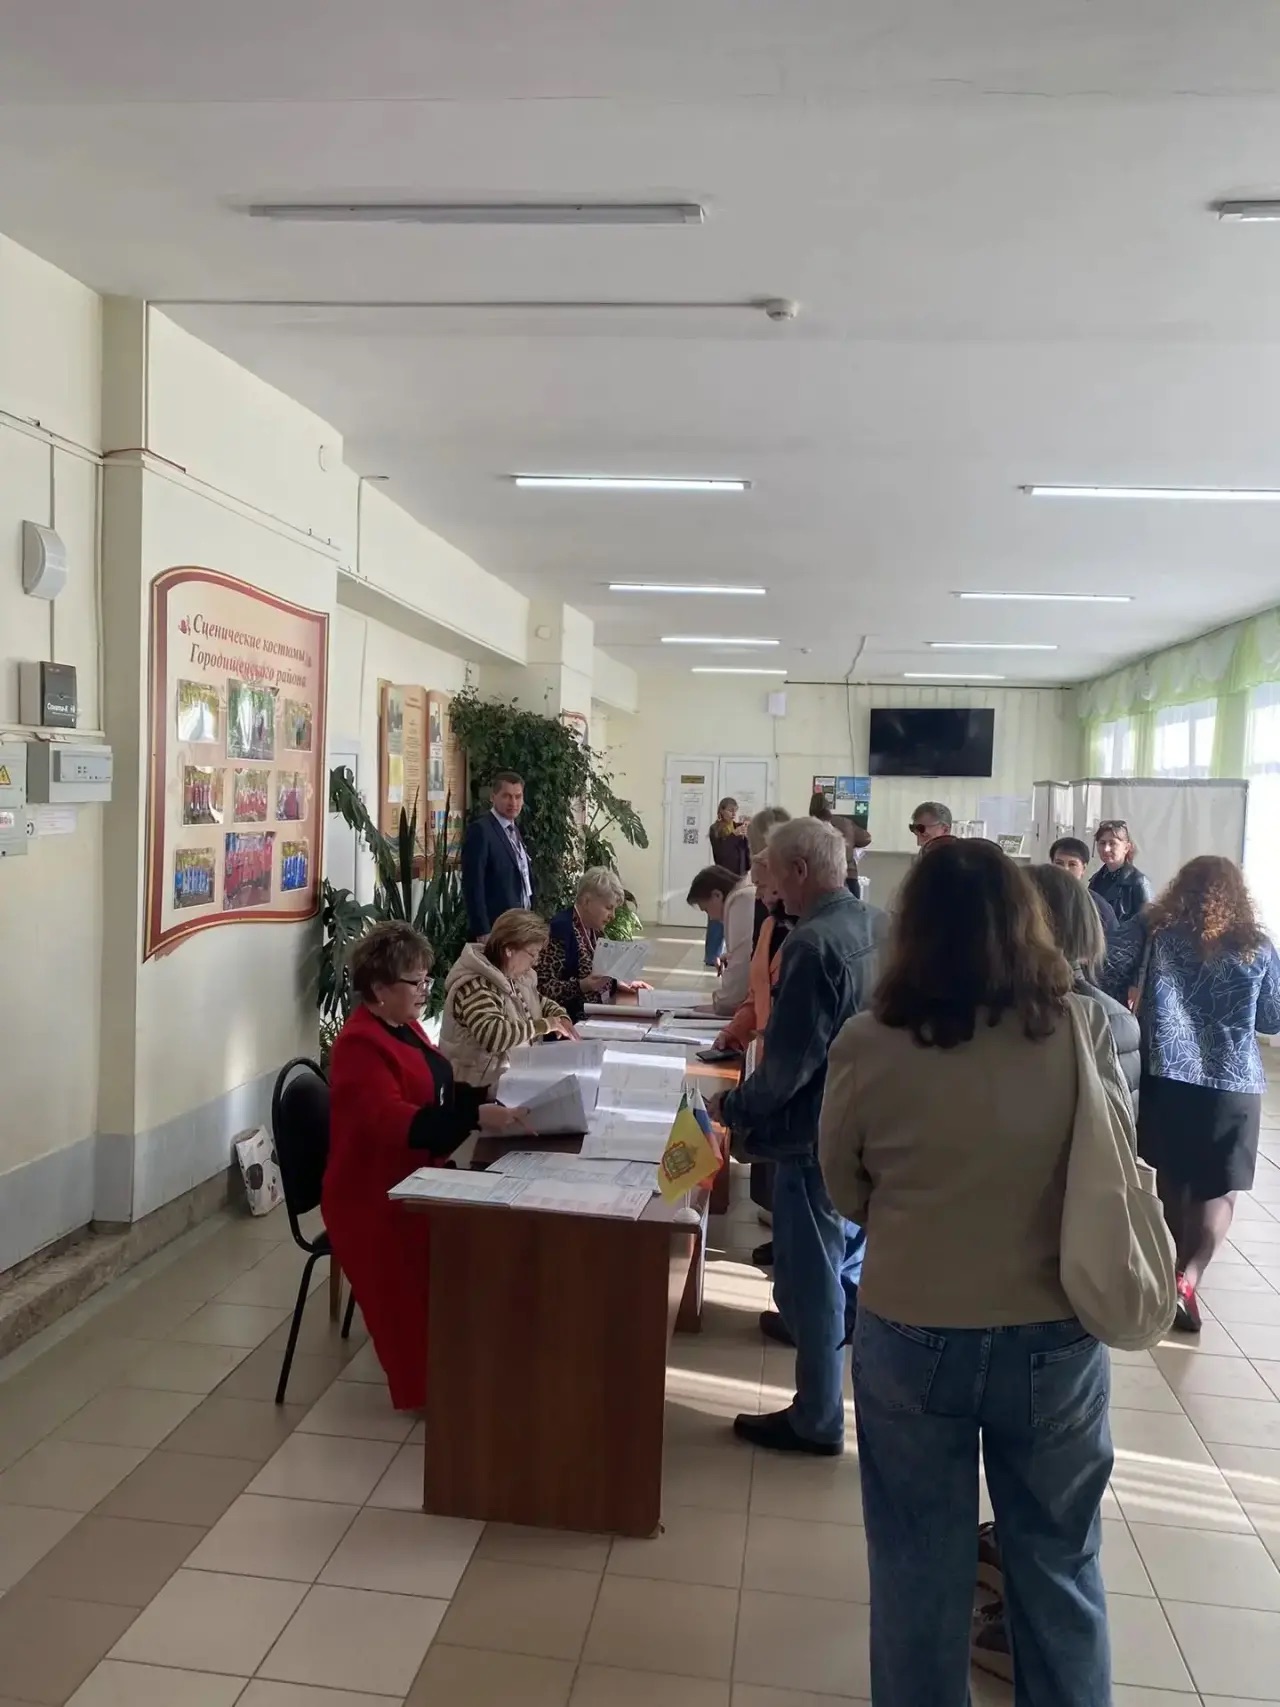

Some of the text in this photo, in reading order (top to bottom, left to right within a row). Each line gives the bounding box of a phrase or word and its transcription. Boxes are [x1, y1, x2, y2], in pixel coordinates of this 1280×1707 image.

[193, 613, 305, 661] Сценические костюмы
[190, 642, 306, 688] Городищенского района
